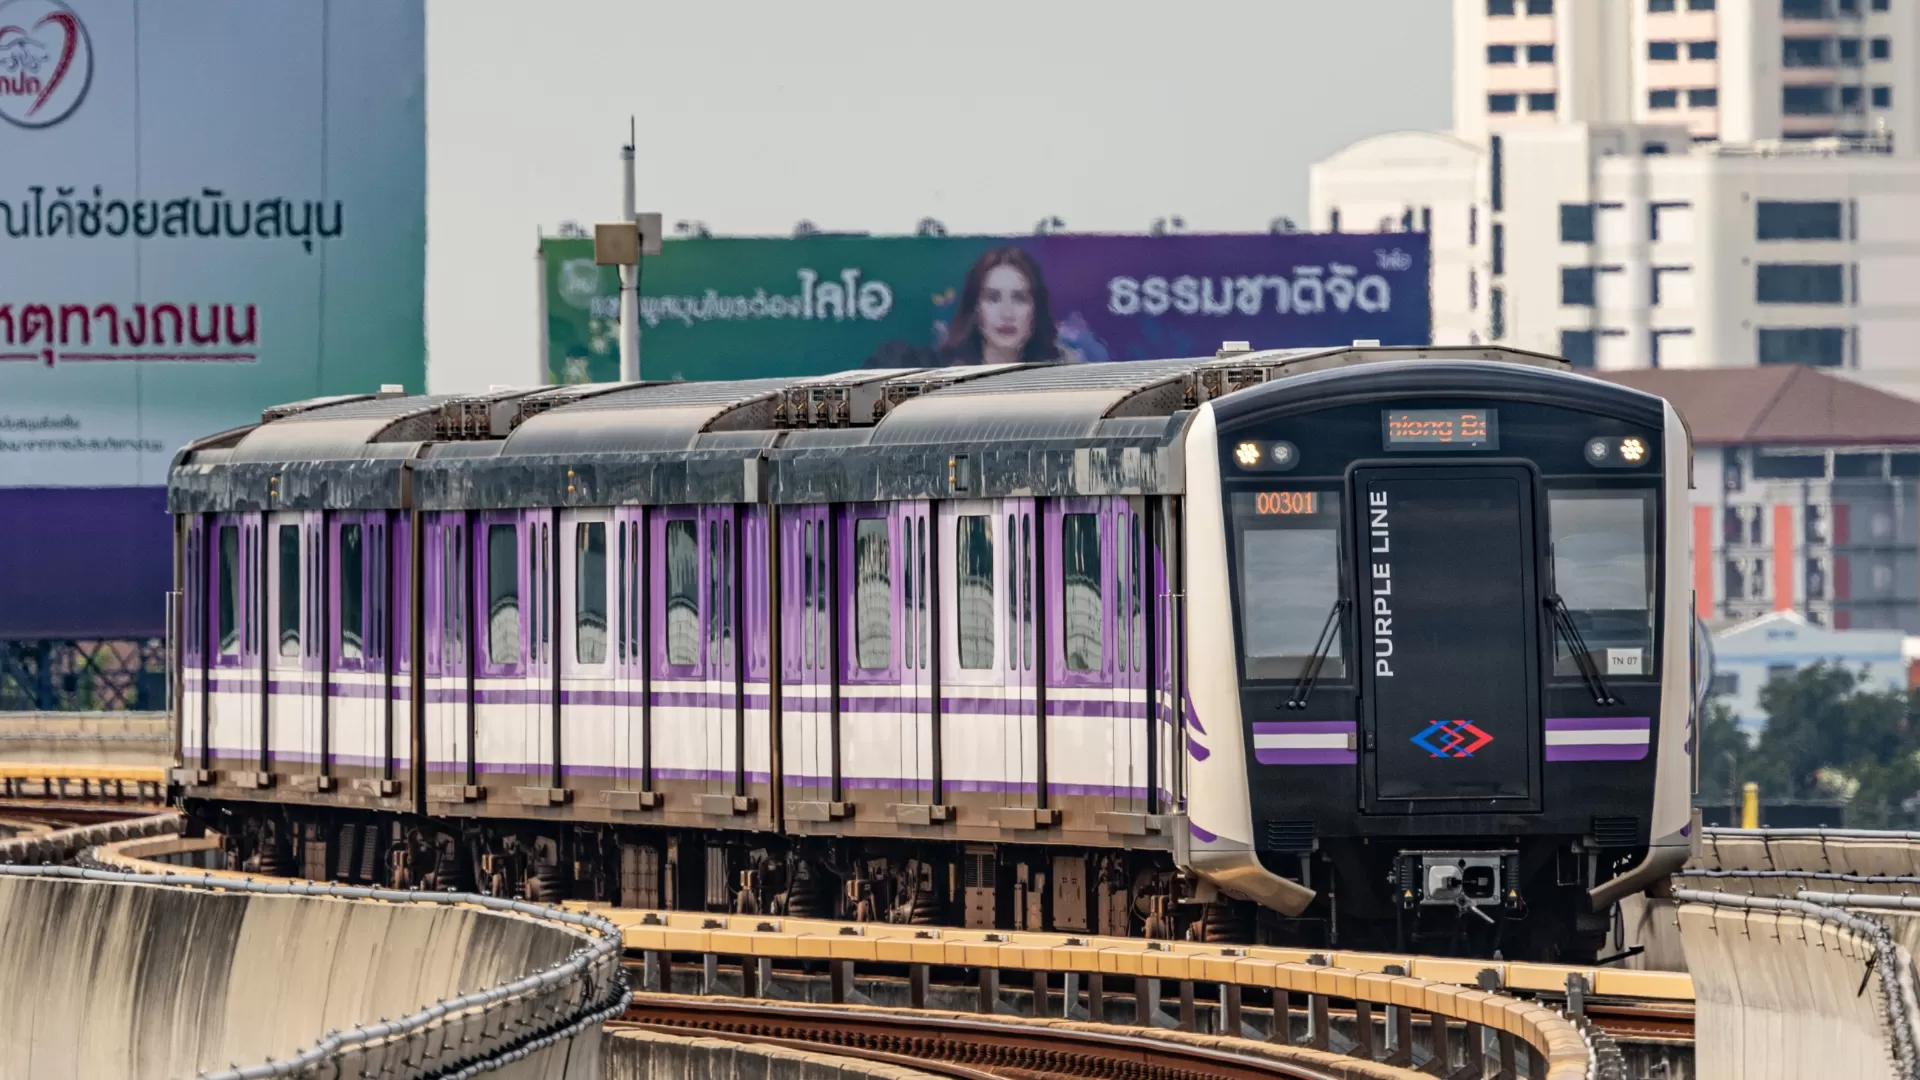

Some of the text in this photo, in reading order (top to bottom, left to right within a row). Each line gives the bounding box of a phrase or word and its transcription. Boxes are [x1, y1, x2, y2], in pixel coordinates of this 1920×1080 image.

[1257, 491, 1313, 514] 00301
[1370, 491, 1394, 677] PURPLE LINE
[1612, 656, 1638, 665] TN 07
